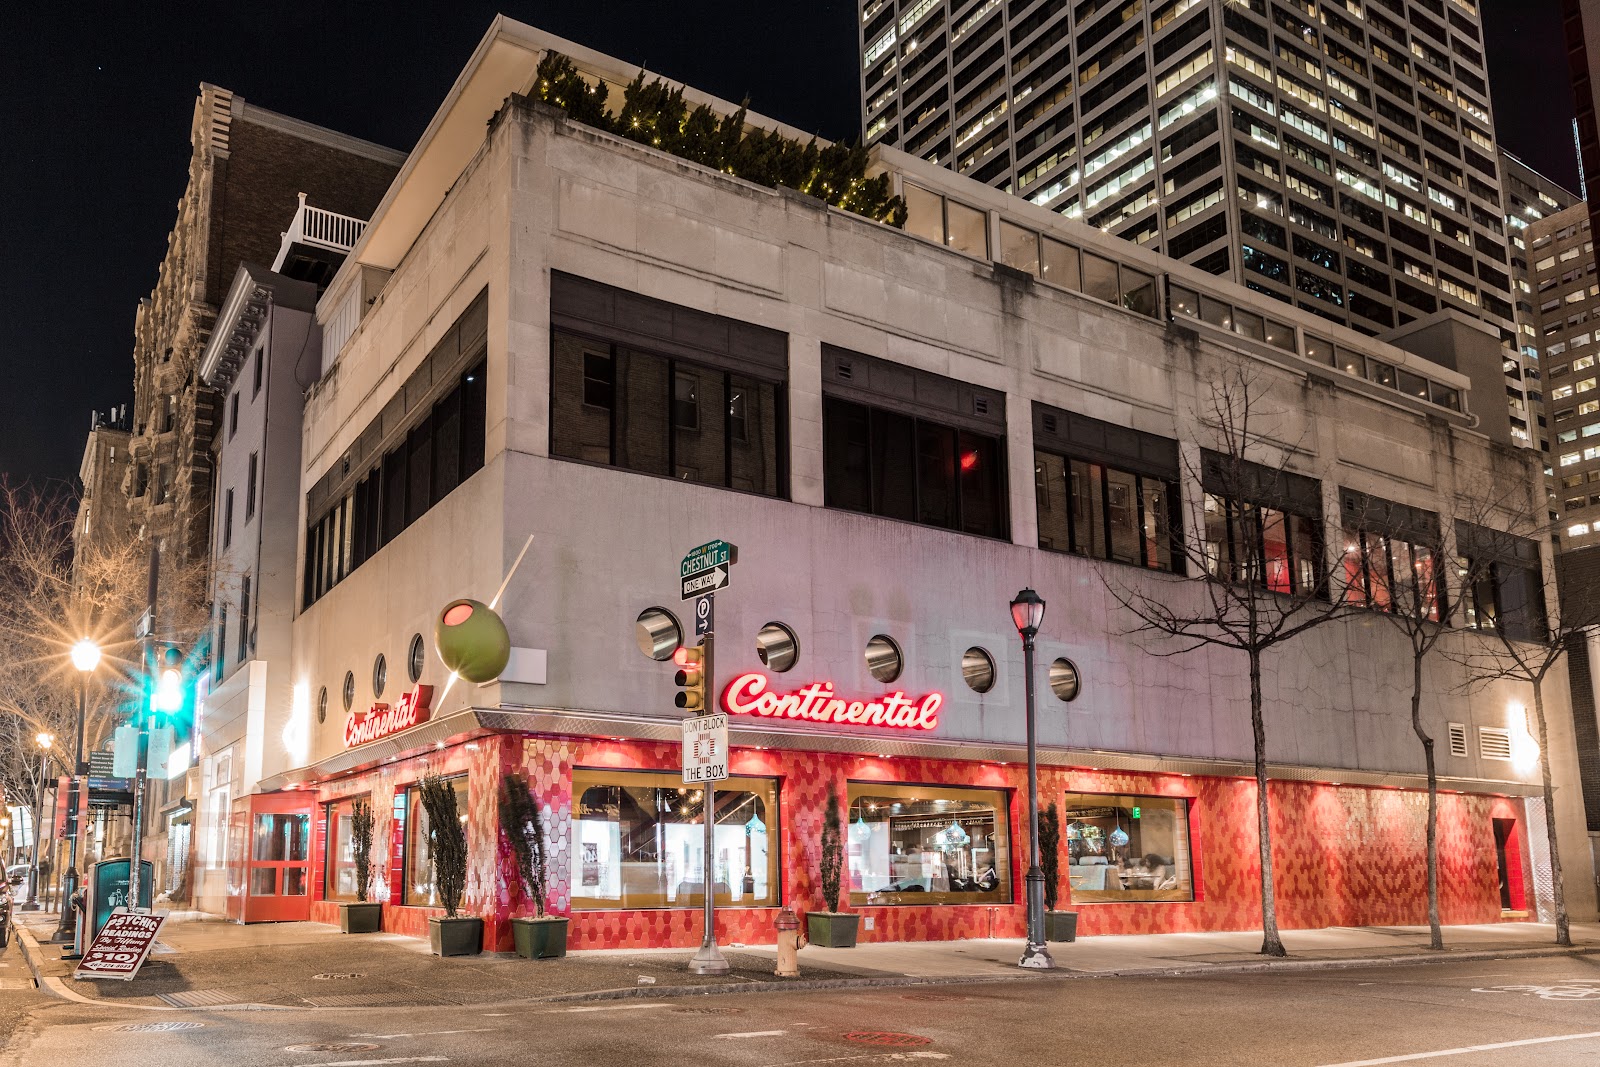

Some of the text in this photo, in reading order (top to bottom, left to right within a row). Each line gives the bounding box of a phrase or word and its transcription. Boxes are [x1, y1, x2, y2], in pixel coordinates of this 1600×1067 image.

[682, 551, 727, 575] CHESTNUT ST
[686, 574, 715, 592] ONE WAY
[725, 673, 942, 730] Continental
[343, 684, 420, 748] Continental
[703, 717, 725, 730] BLOCK
[685, 764, 724, 780] THE BOX
[106, 915, 158, 931] PSYCHIC
[101, 929, 153, 939] READINGS
